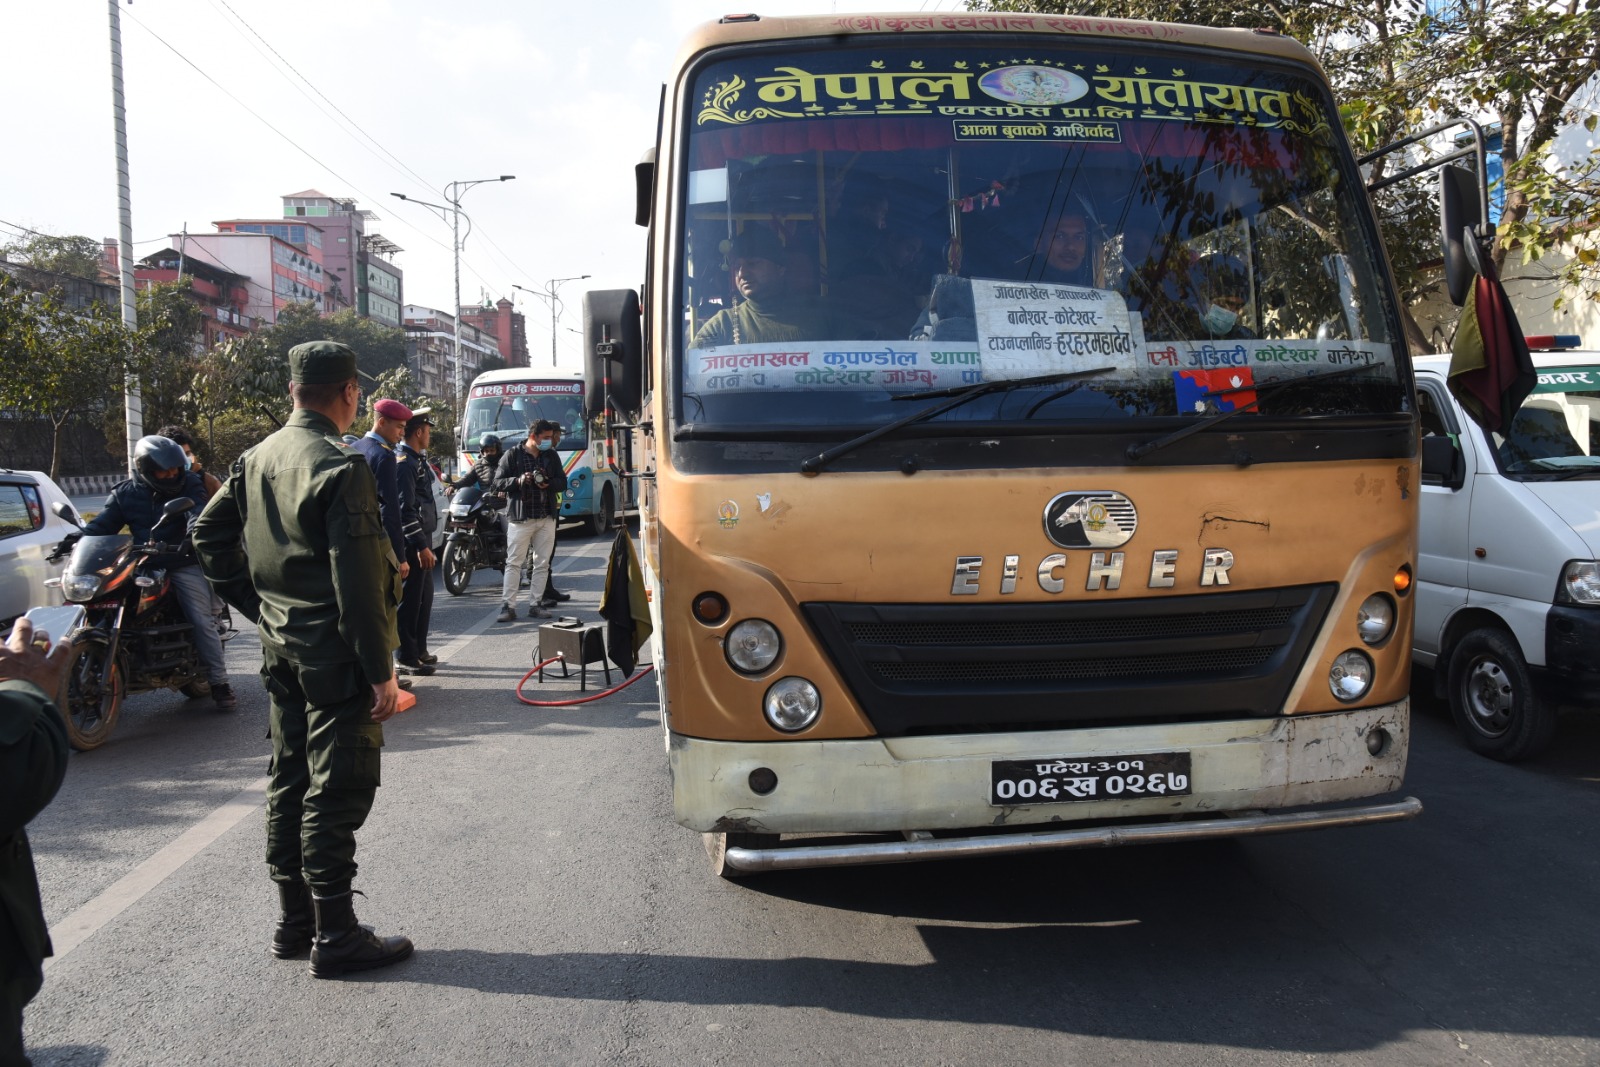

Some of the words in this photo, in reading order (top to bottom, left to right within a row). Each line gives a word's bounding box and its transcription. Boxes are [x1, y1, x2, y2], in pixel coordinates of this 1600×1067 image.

[885, 18, 934, 32] कुल
[755, 67, 974, 103] नेपाल
[1092, 75, 1291, 118] यातायात
[959, 124, 997, 137] आमा
[1002, 122, 1047, 139] बुवाको
[951, 547, 1235, 595] EICHER
[1063, 776, 1100, 797] ख
[1105, 772, 1188, 795] ०२६७
